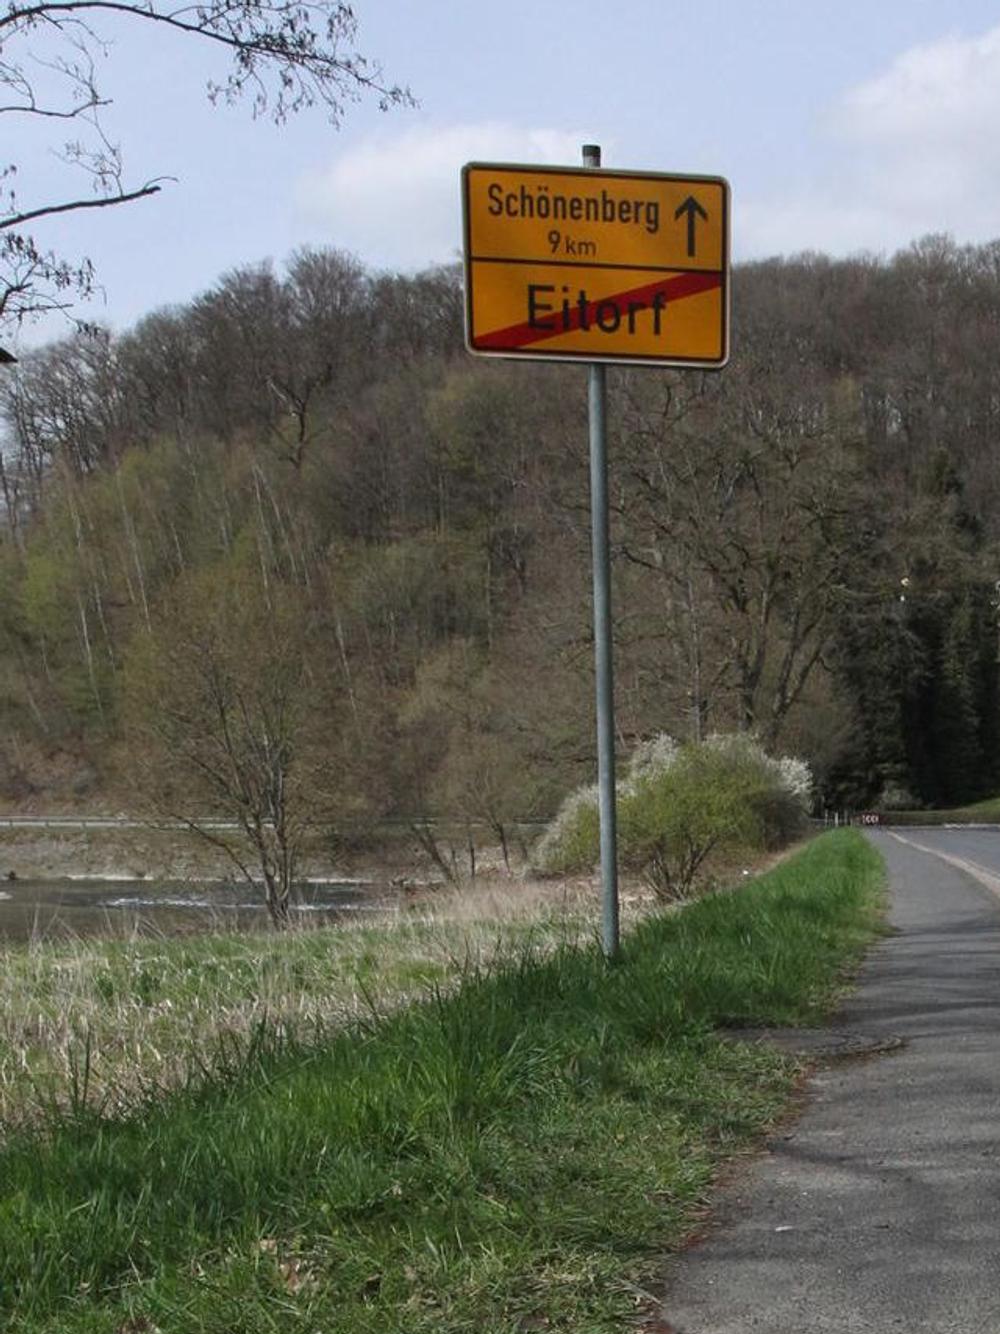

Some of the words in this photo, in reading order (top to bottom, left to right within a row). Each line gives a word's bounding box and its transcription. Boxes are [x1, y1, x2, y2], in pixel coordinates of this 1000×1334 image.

[488, 183, 659, 233] Schönenberg
[548, 230, 561, 253] 9
[565, 236, 597, 256] km
[527, 284, 667, 336] Eitorf
